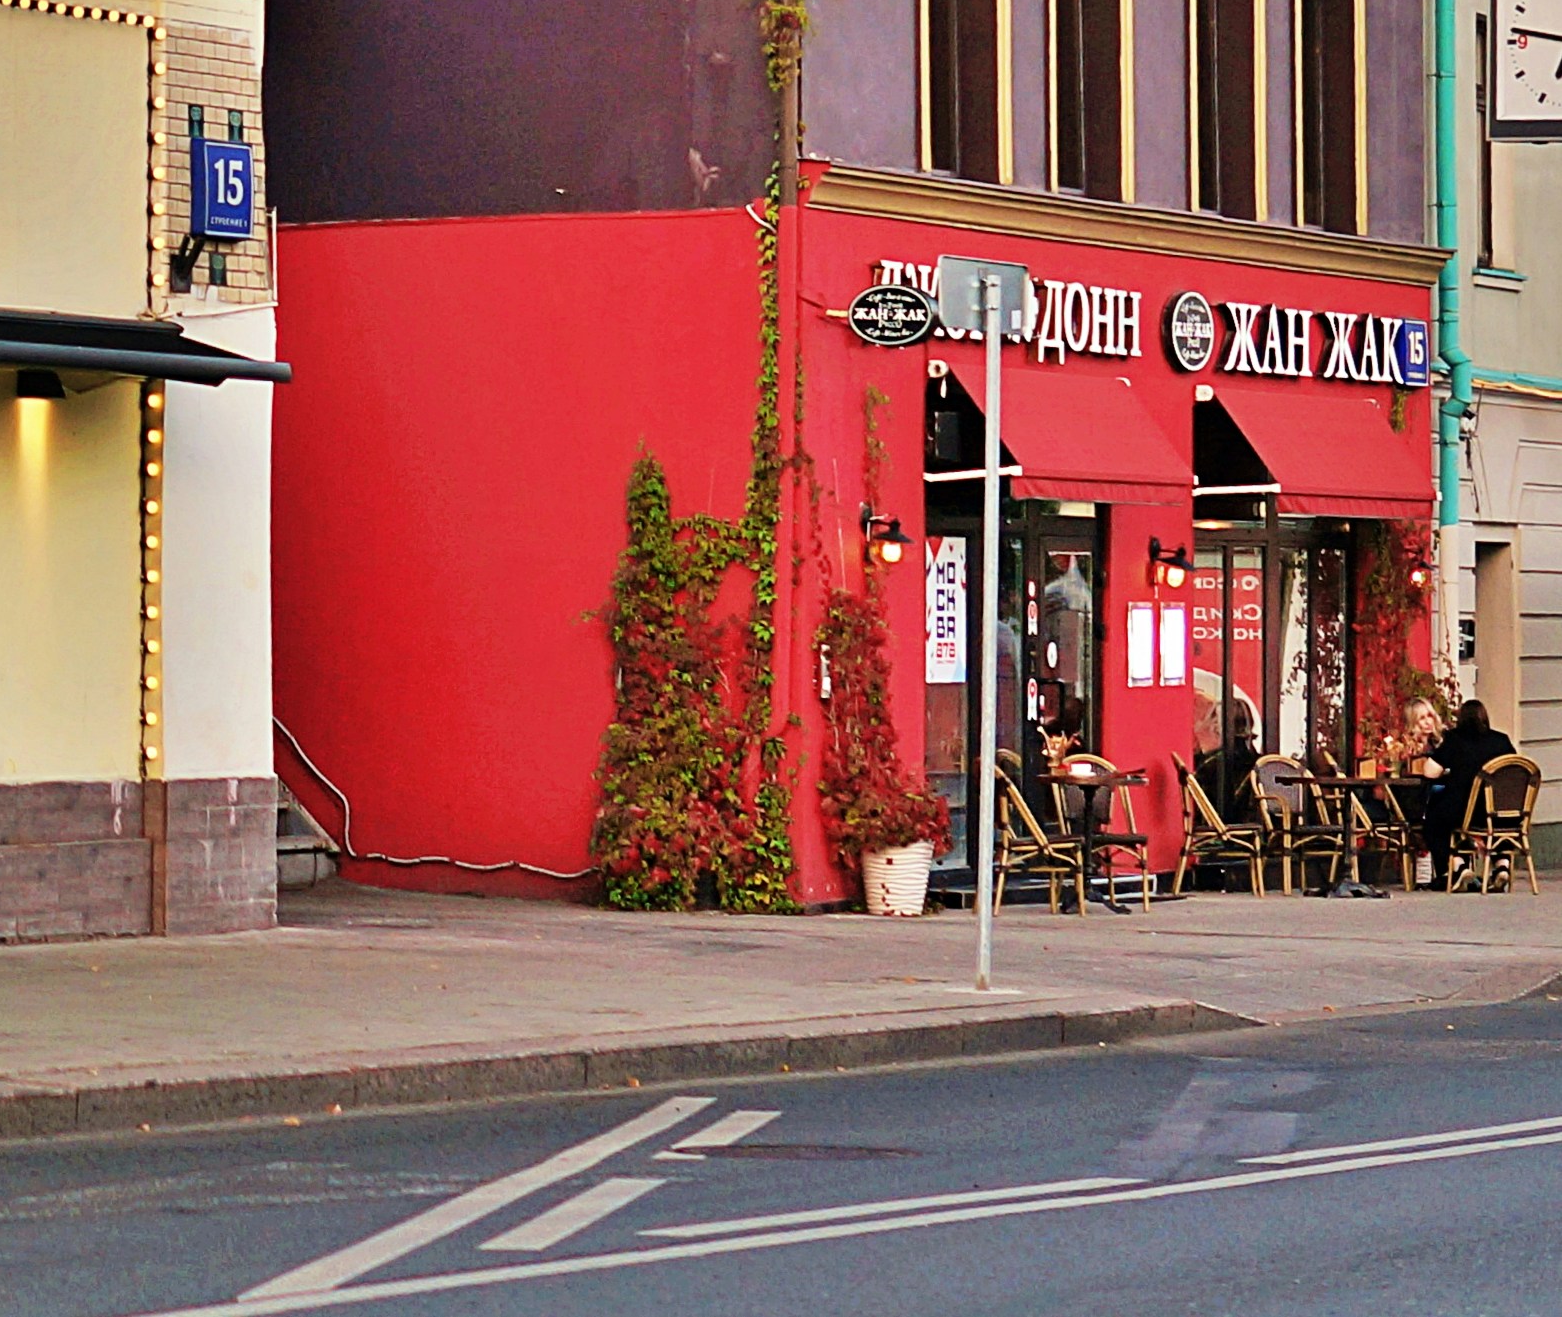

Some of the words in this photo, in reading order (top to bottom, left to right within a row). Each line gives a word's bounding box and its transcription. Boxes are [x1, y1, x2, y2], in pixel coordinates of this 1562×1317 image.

[1517, 33, 1528, 49] 9
[214, 158, 244, 206] 15
[1038, 279, 1142, 364] ДОНН
[1224, 301, 1313, 377] ЖАН
[1323, 311, 1404, 384] ЖАК
[1408, 331, 1424, 364] 15
[936, 561, 956, 585] МО
[936, 588, 956, 612] СК
[936, 616, 956, 639] ВА
